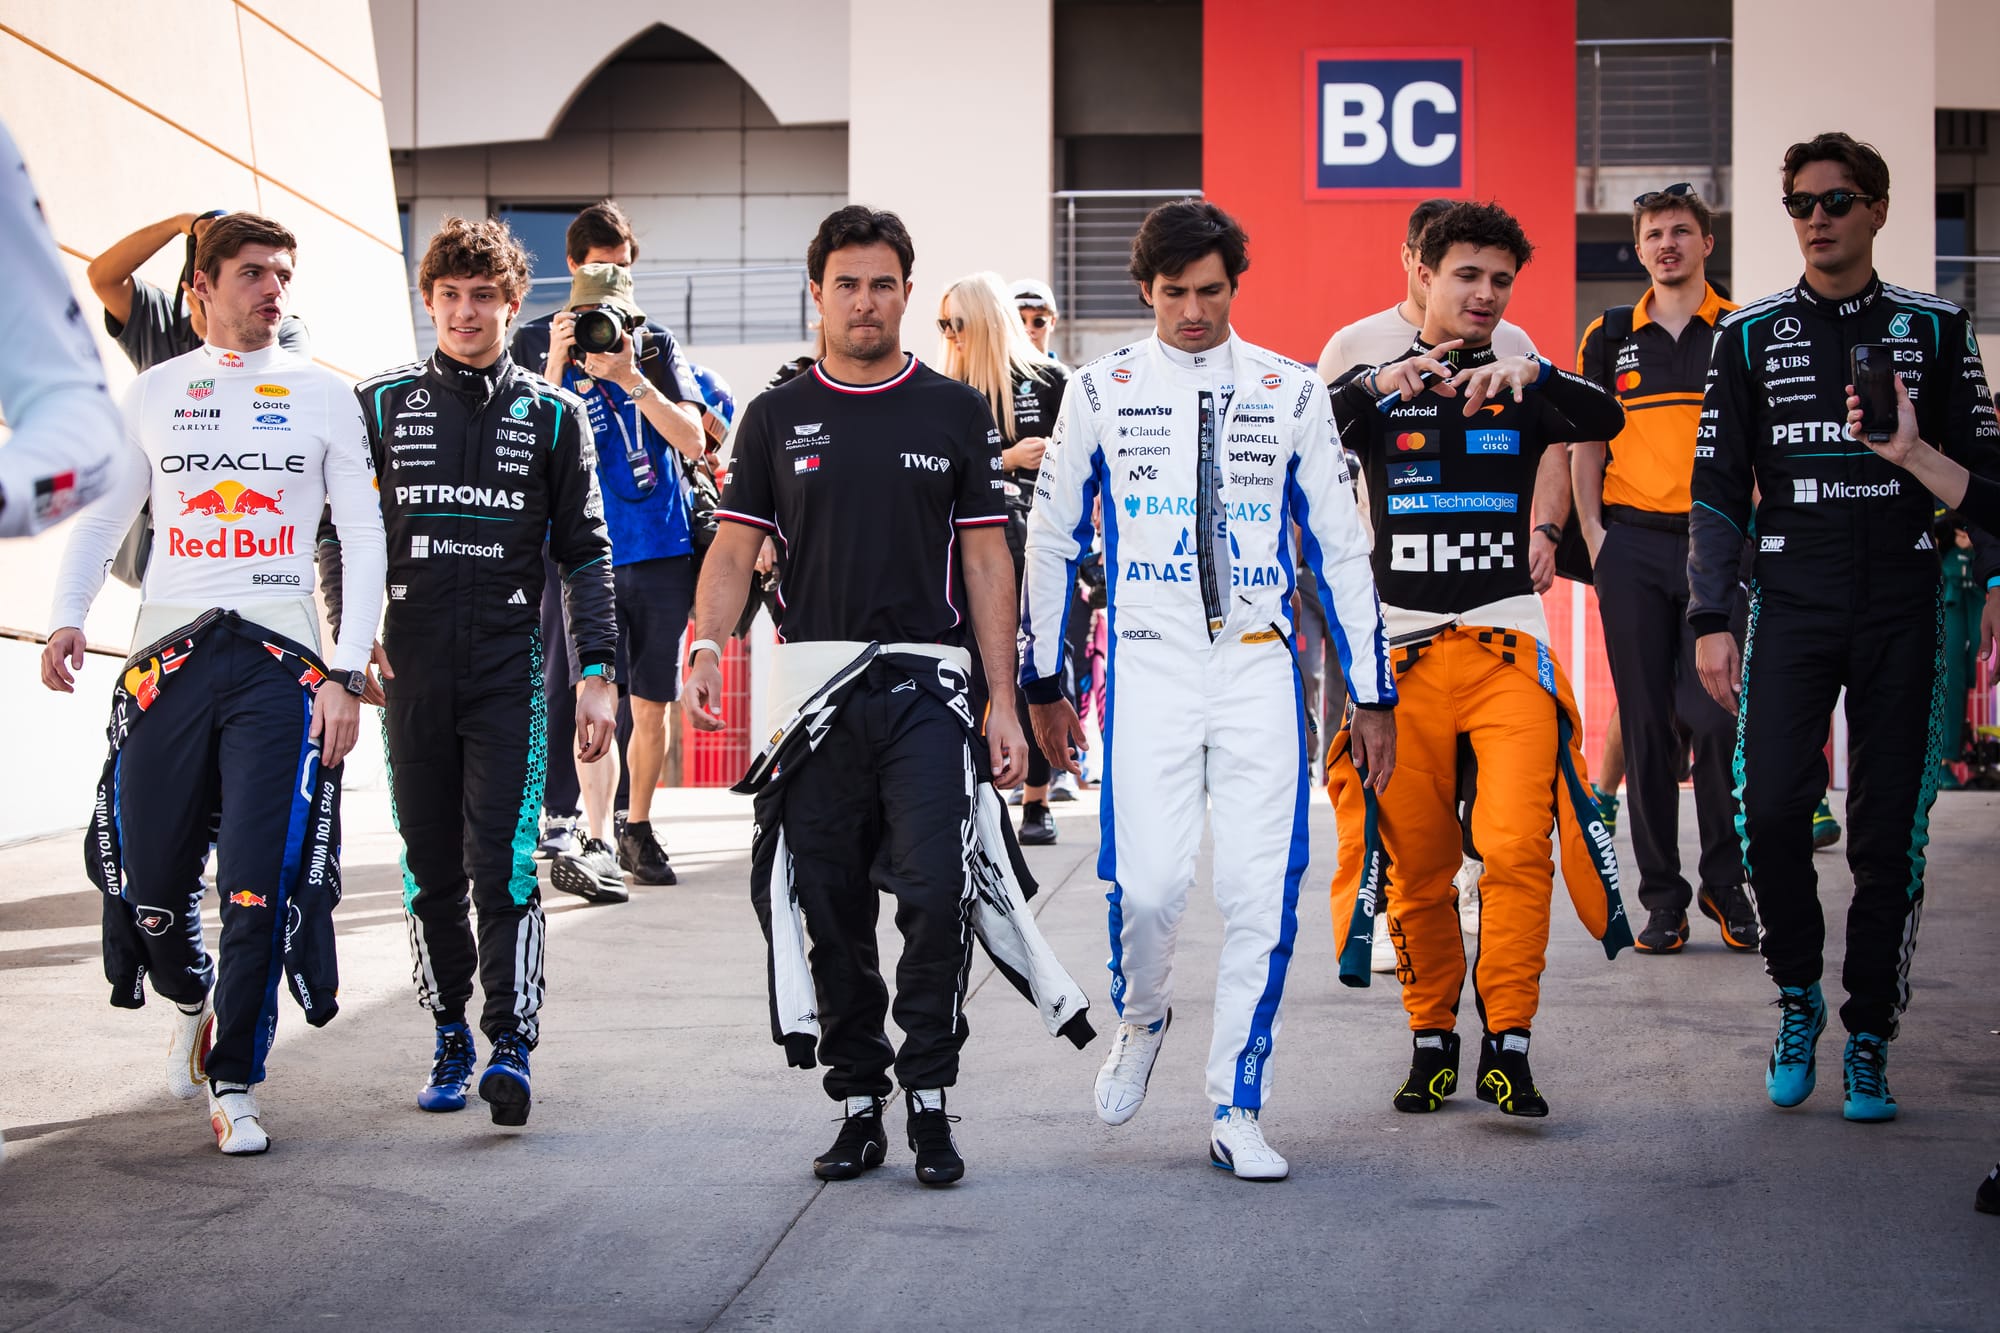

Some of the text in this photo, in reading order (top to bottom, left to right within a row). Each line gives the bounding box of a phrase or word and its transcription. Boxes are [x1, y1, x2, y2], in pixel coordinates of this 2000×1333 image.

[1323, 80, 1457, 167] BC
[1782, 355, 1810, 368] UBS
[1894, 350, 1923, 362] EOS
[1768, 376, 1816, 387] CROWDSTRIKE
[1894, 370, 1922, 382] ignify
[190, 381, 212, 389] TAG
[188, 388, 212, 398] HEUER
[1081, 372, 1101, 413] sparco
[1294, 380, 1314, 419] sparco
[1776, 394, 1816, 404] Snapdragon
[174, 409, 207, 418] Mobil
[1118, 406, 1172, 416] KOMATSU
[1390, 405, 1438, 418] Android
[502, 417, 534, 427] PETRONAS
[409, 426, 434, 436] UBS
[496, 429, 536, 445] INEOS
[1130, 426, 1171, 436] Claude
[1772, 422, 1857, 445] PETRO
[786, 434, 830, 446] CADILLAC
[1228, 434, 1279, 444] URACELL
[394, 444, 437, 452] CROWDSTRIKE
[161, 454, 306, 473] ORACLE
[400, 460, 436, 468] Snapdragon
[900, 453, 938, 472] TWG
[1229, 450, 1276, 466] betway
[498, 462, 530, 476] HPE
[1822, 480, 1900, 499] Microsoft
[395, 485, 526, 510] PETRONAS
[1392, 494, 1514, 511] DELL Technologies
[170, 526, 294, 558] Red Bull
[1761, 538, 1785, 550] OMP
[433, 540, 504, 559] Microsoft
[1391, 532, 1514, 572] OKX
[252, 573, 300, 586] sparco
[391, 588, 407, 598] OMP
[1122, 629, 1162, 640] sparco
[95, 784, 120, 896] GIVES YOU WINGS
[309, 781, 335, 886] GIVES YOU WINGS
[1588, 820, 1619, 890] allwyn
[1358, 850, 1380, 918] allwyn
[134, 965, 145, 1000] sparco
[294, 974, 312, 1010] sparco
[1243, 1036, 1266, 1086] sparco
